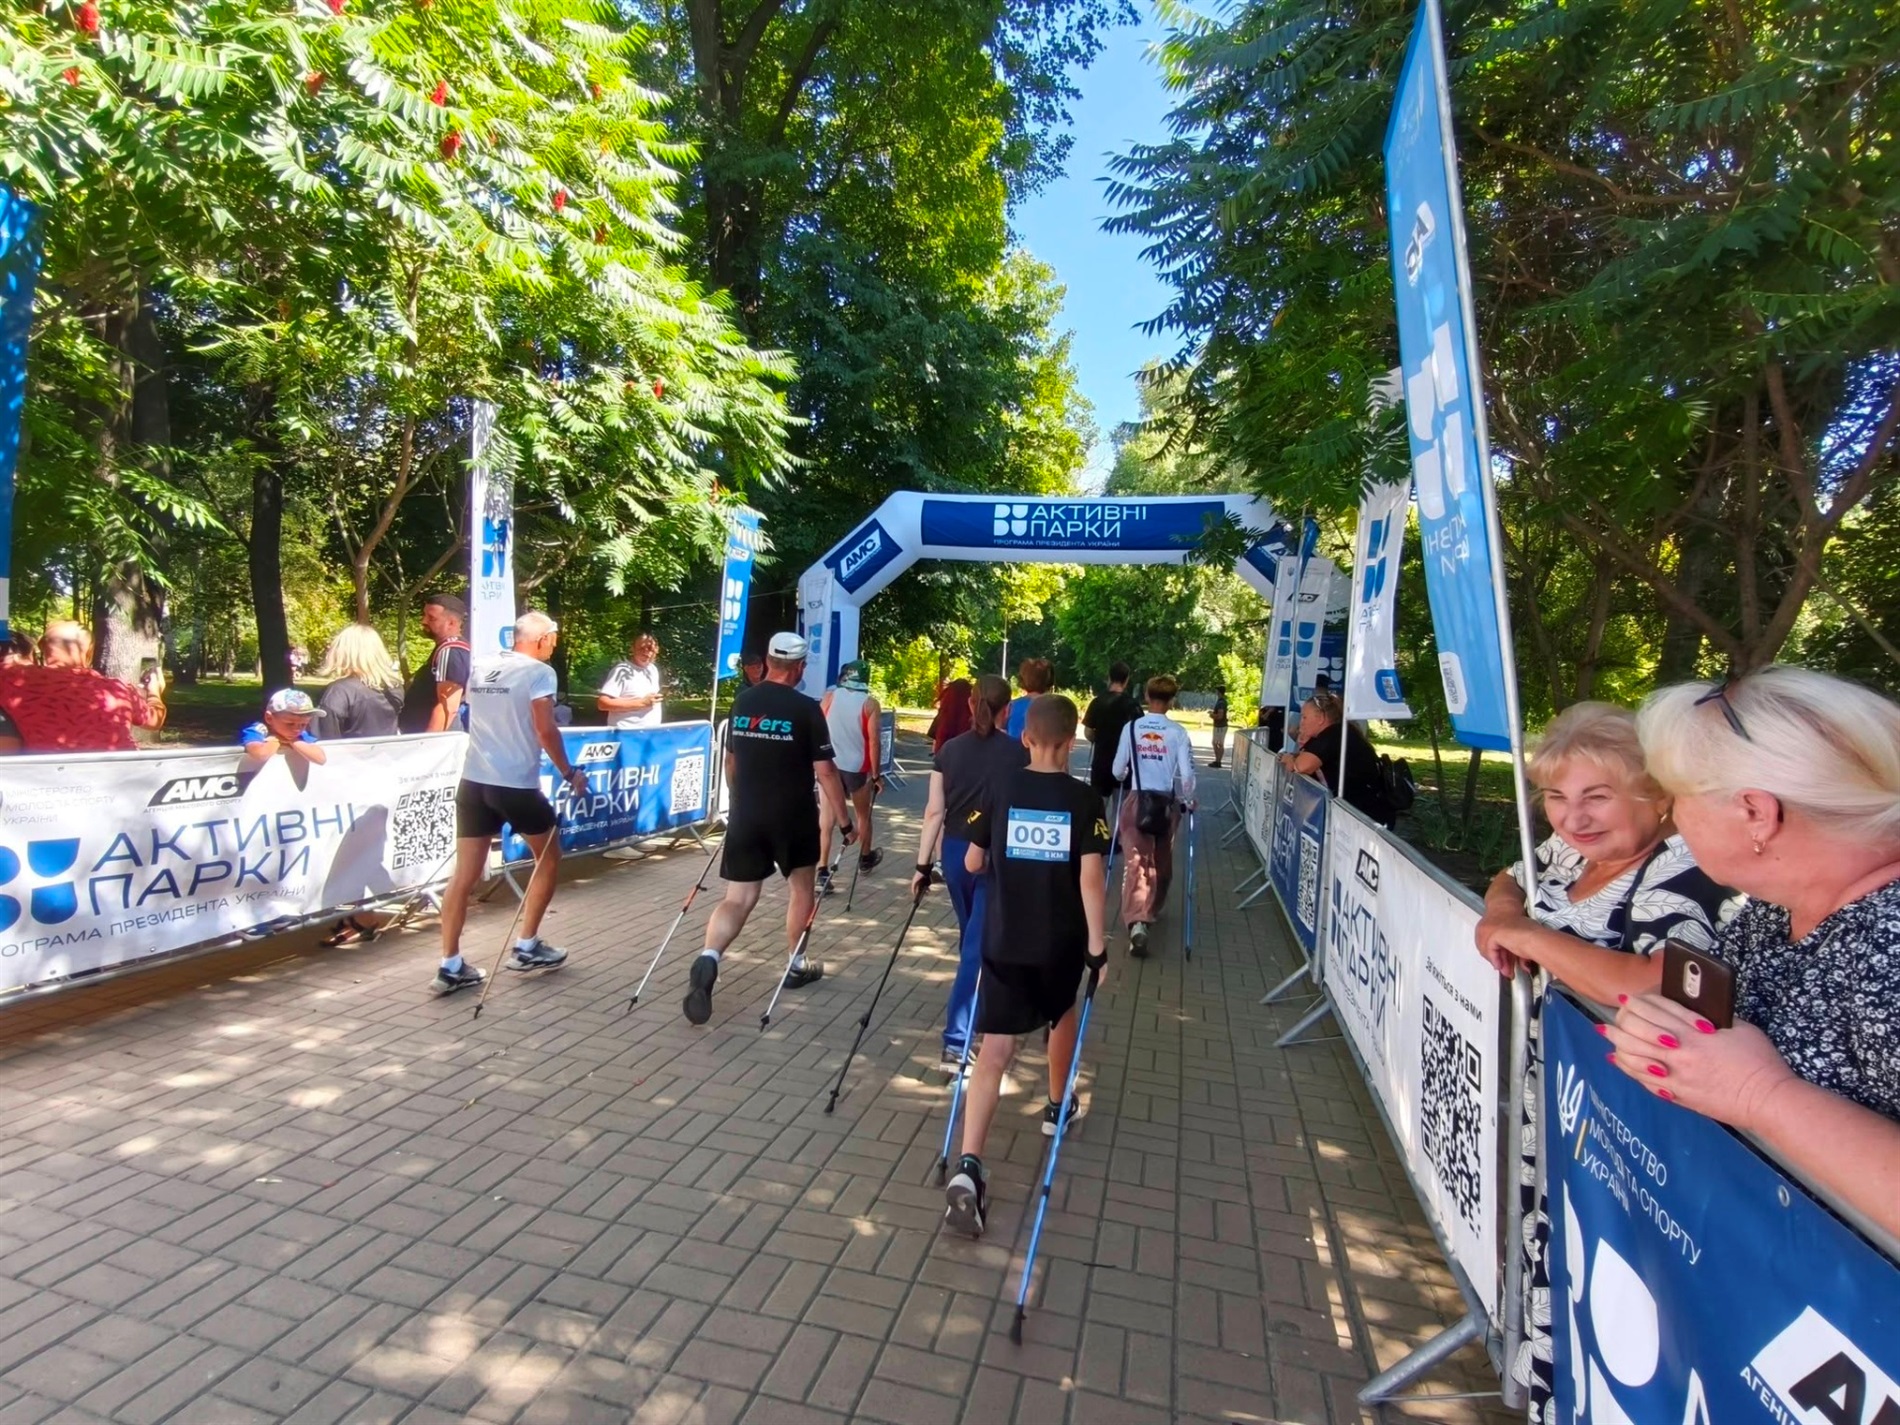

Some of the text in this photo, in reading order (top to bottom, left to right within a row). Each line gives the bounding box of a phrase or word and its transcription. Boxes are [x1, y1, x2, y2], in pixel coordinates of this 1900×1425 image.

[1032, 504, 1147, 521] АКТИВНІ
[1030, 520, 1121, 538] ПАРКИ
[733, 714, 793, 733] savers
[5, 799, 55, 813] МОЛОД
[3, 813, 58, 826] УКРАЇНИ
[91, 803, 356, 872] АКТИВНІ
[1014, 825, 1061, 846] 003
[88, 845, 310, 916] ПАРКИ
[0, 884, 306, 958] ОГРАМА ПРЕЗИДЕНТА УКРАЇНИ
[1340, 889, 1402, 1013] АКТИВНІ
[1639, 1188, 1702, 1266] СПОРТУ
